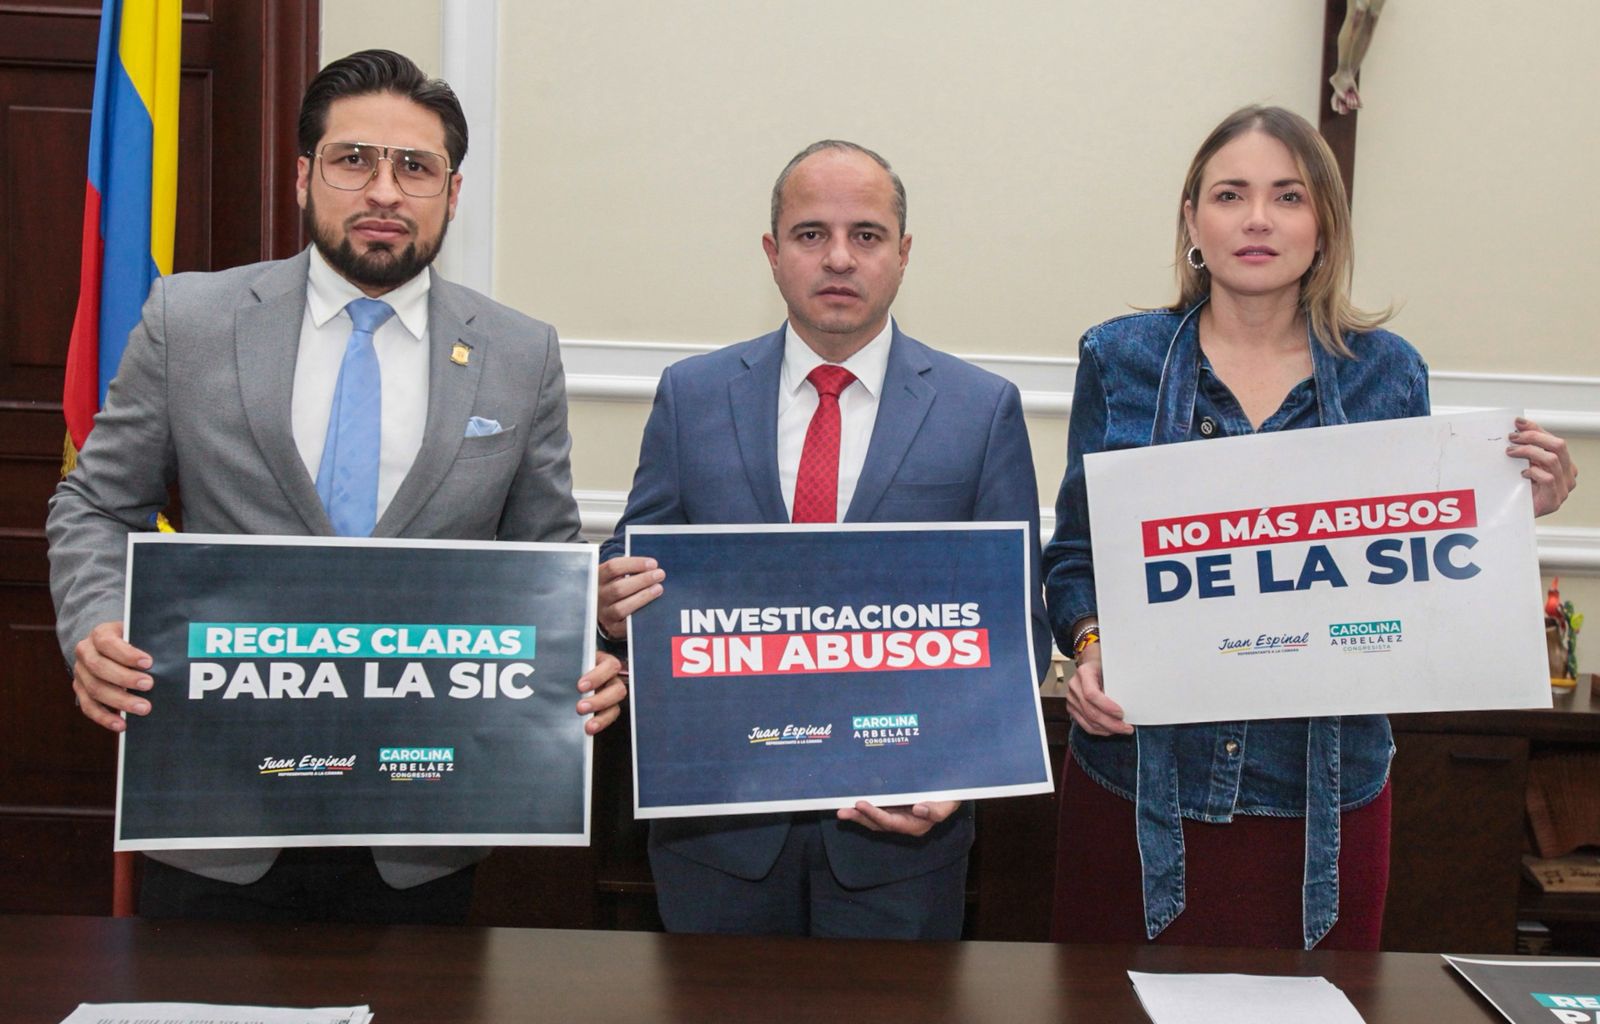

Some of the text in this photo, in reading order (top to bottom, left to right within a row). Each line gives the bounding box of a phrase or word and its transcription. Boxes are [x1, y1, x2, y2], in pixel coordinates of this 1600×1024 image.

[1157, 497, 1461, 550] NO MÁS ABUSOS
[1145, 533, 1482, 604] DE LA SIC
[680, 602, 981, 633] INVESTIGACIONES
[206, 626, 522, 655] REGLAS CLARAS
[1218, 632, 1309, 650] Juan Espinal
[1331, 634, 1403, 646] ARBELÁEZ
[1343, 643, 1391, 652] CONGRESISTA
[680, 630, 983, 674] SIN ABUSOS
[188, 661, 536, 700] PARA LA SIC
[747, 723, 833, 740] Juan Espinal
[864, 736, 909, 744] CONGRESISTA
[258, 754, 357, 771] Juan Espinal
[378, 762, 454, 772] ARBELÁEZ
